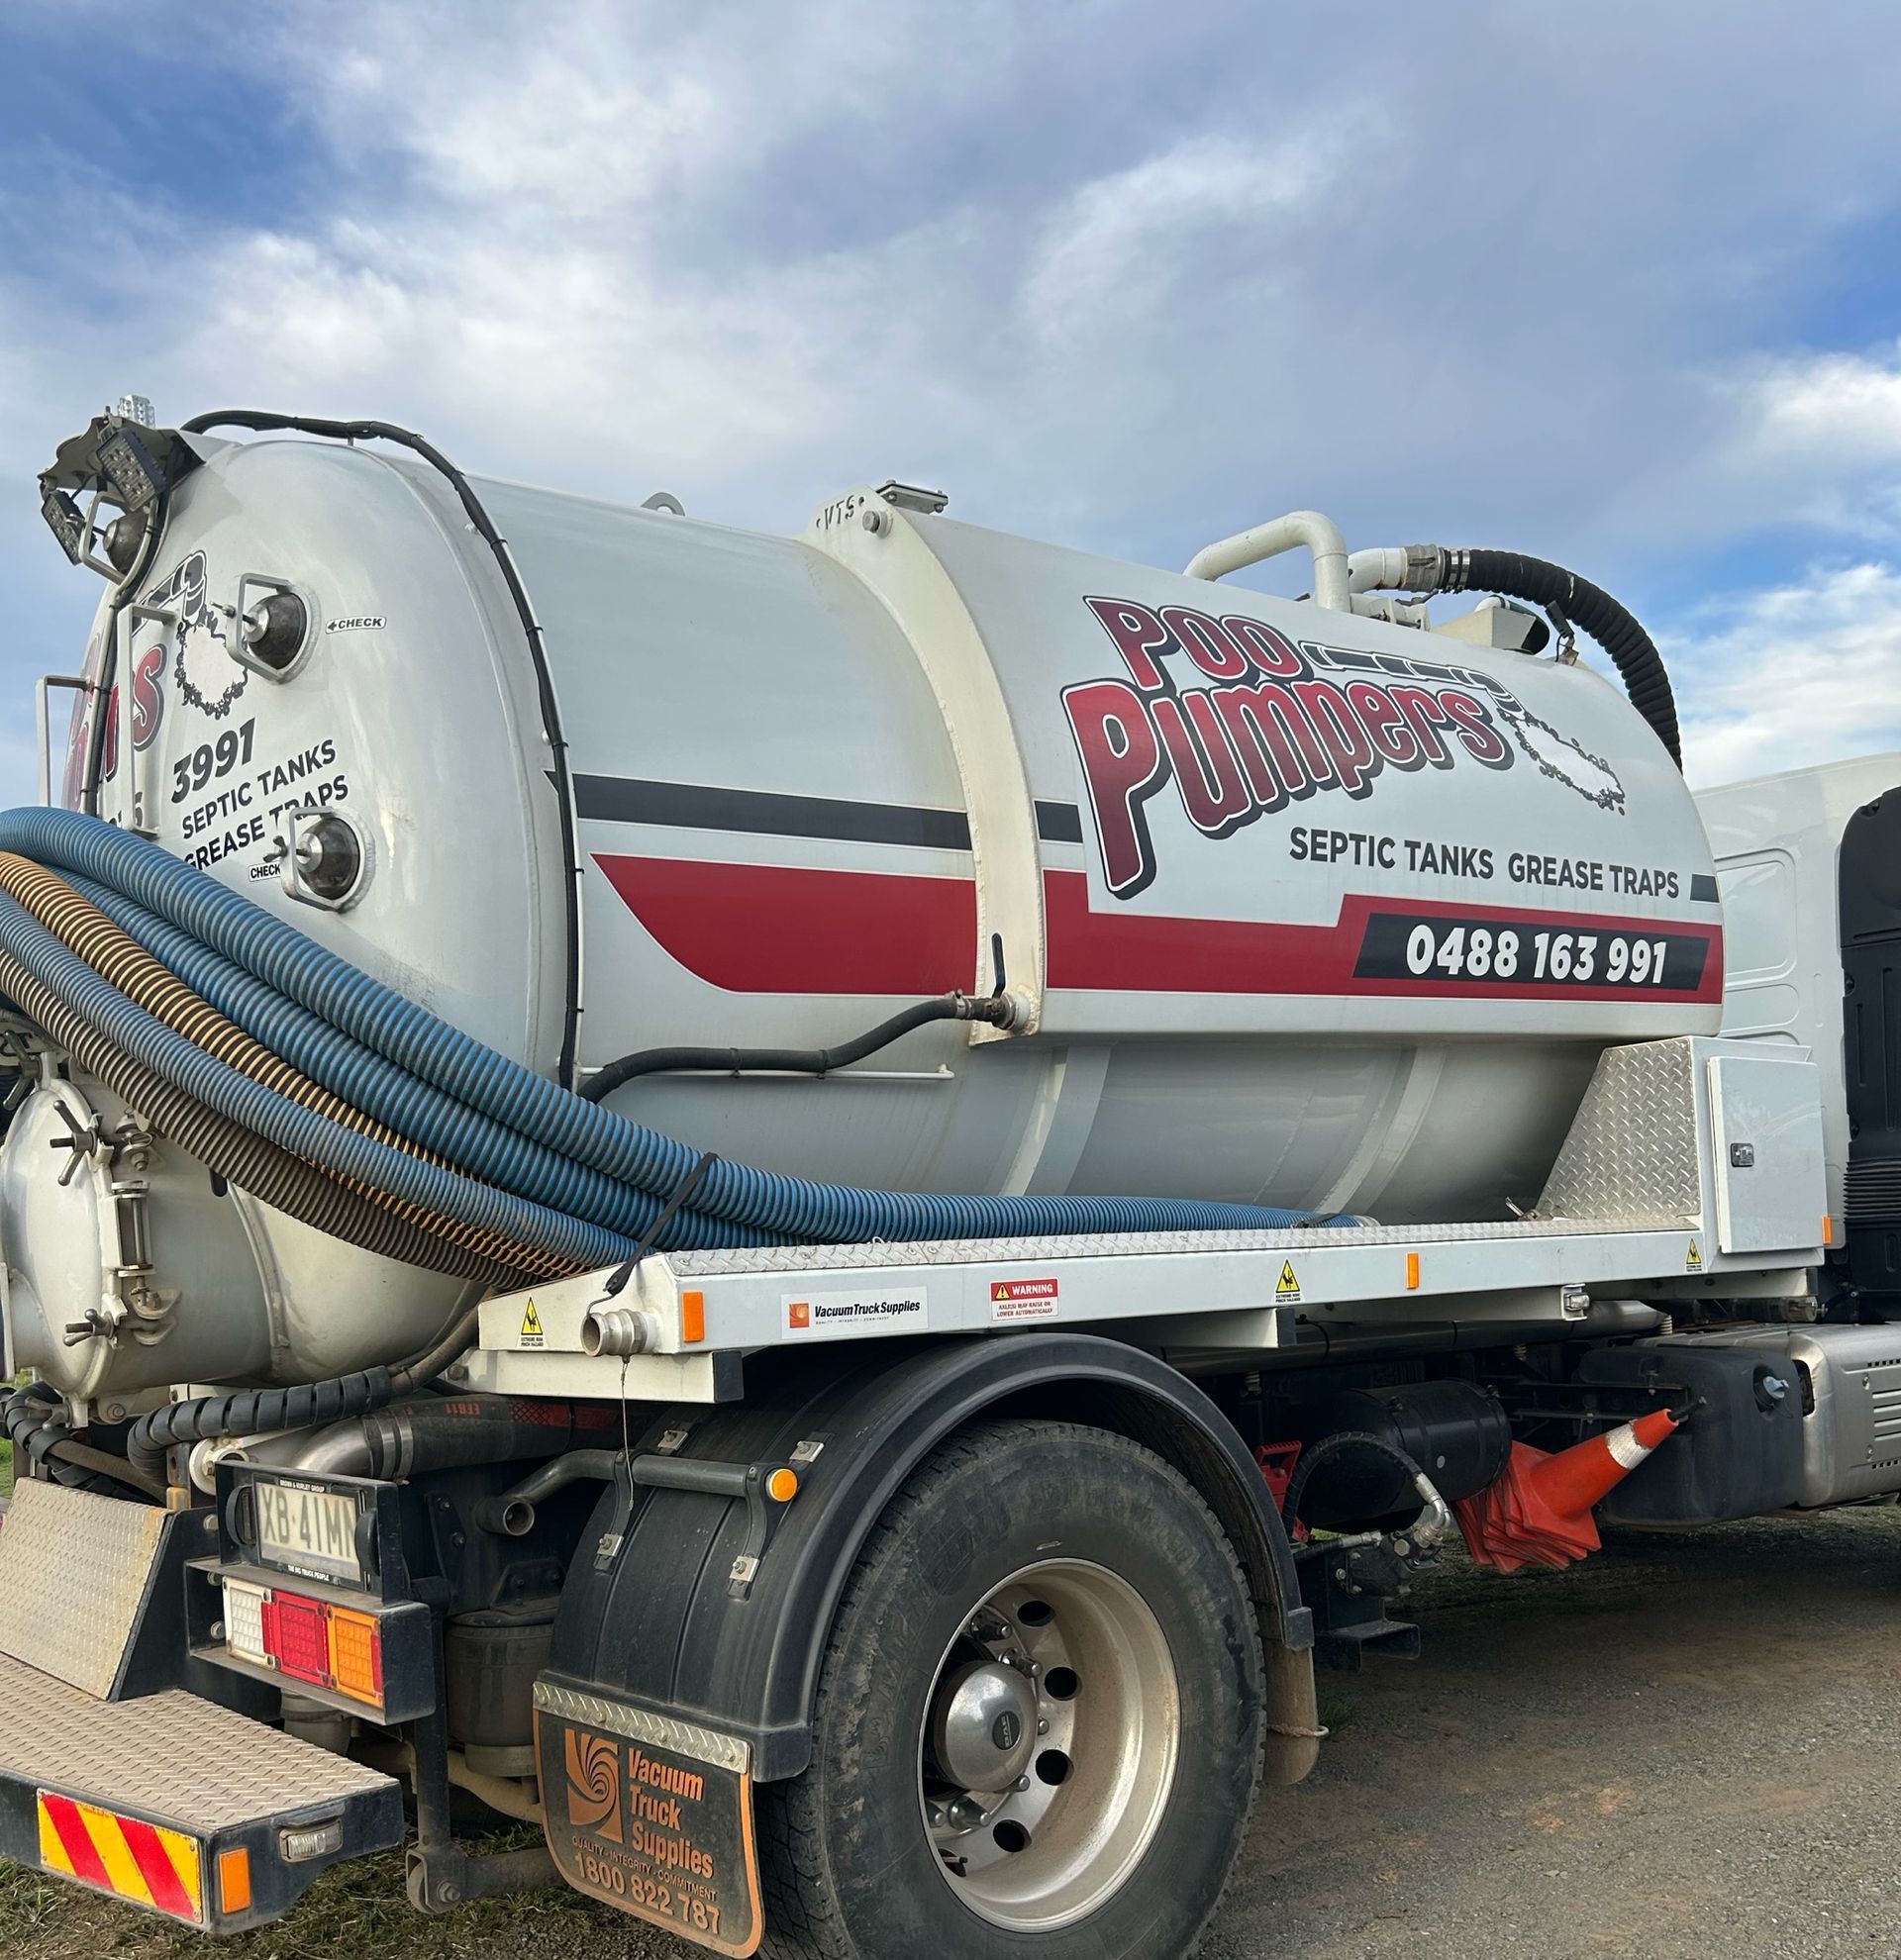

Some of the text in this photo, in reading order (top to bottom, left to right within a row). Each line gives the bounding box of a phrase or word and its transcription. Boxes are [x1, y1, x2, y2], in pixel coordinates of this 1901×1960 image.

[338, 618, 383, 630] CHECK
[182, 782, 252, 839] SEPTIC
[257, 739, 337, 796] TANKS
[184, 815, 265, 872] GREASE
[250, 863, 281, 879] CHECK
[1289, 827, 1679, 899] SEPTIC TANKS GREASE TRAPS
[1406, 925, 1667, 984] 0488 163 991
[1012, 1284, 1052, 1295] WARNING
[628, 1747, 705, 1802] Vacuum
[629, 1785, 682, 1831] Truck
[571, 1835, 605, 1857] QUALITY
[610, 1851, 652, 1875] INTEGRITY
[657, 1870, 718, 1902] COMMITMENT
[632, 1821, 715, 1879] Supplies
[575, 1852, 721, 1935] 1800 822 787
